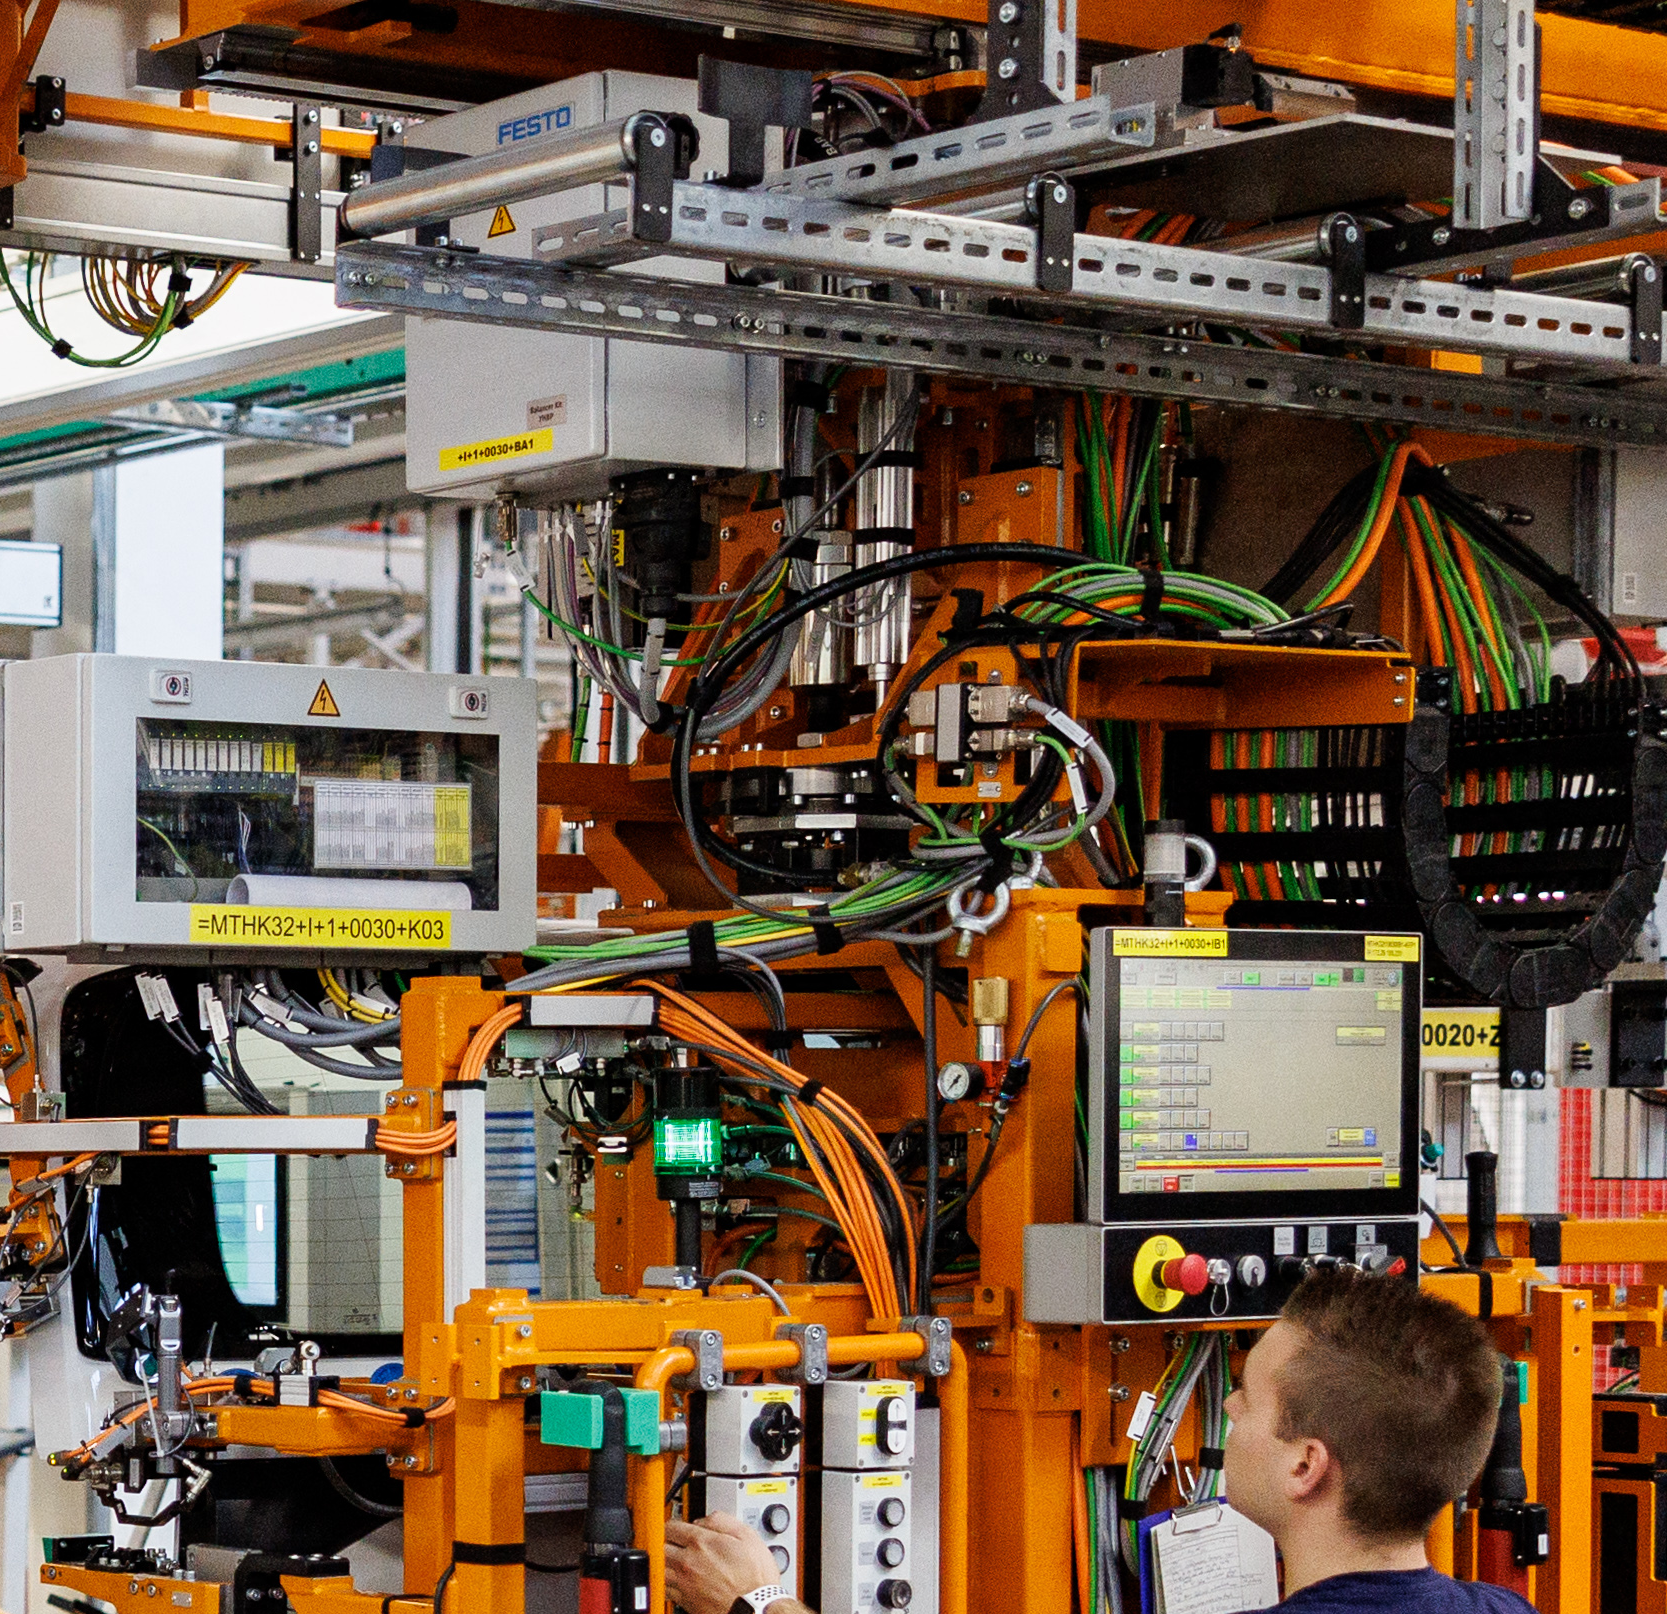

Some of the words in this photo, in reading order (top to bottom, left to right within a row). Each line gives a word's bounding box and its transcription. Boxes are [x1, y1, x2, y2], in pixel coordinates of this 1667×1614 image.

[498, 106, 571, 145] FESTO
[458, 438, 535, 462] +I+1+0030+BA1
[198, 914, 445, 940] =MTHK32+I+1+0030+K03
